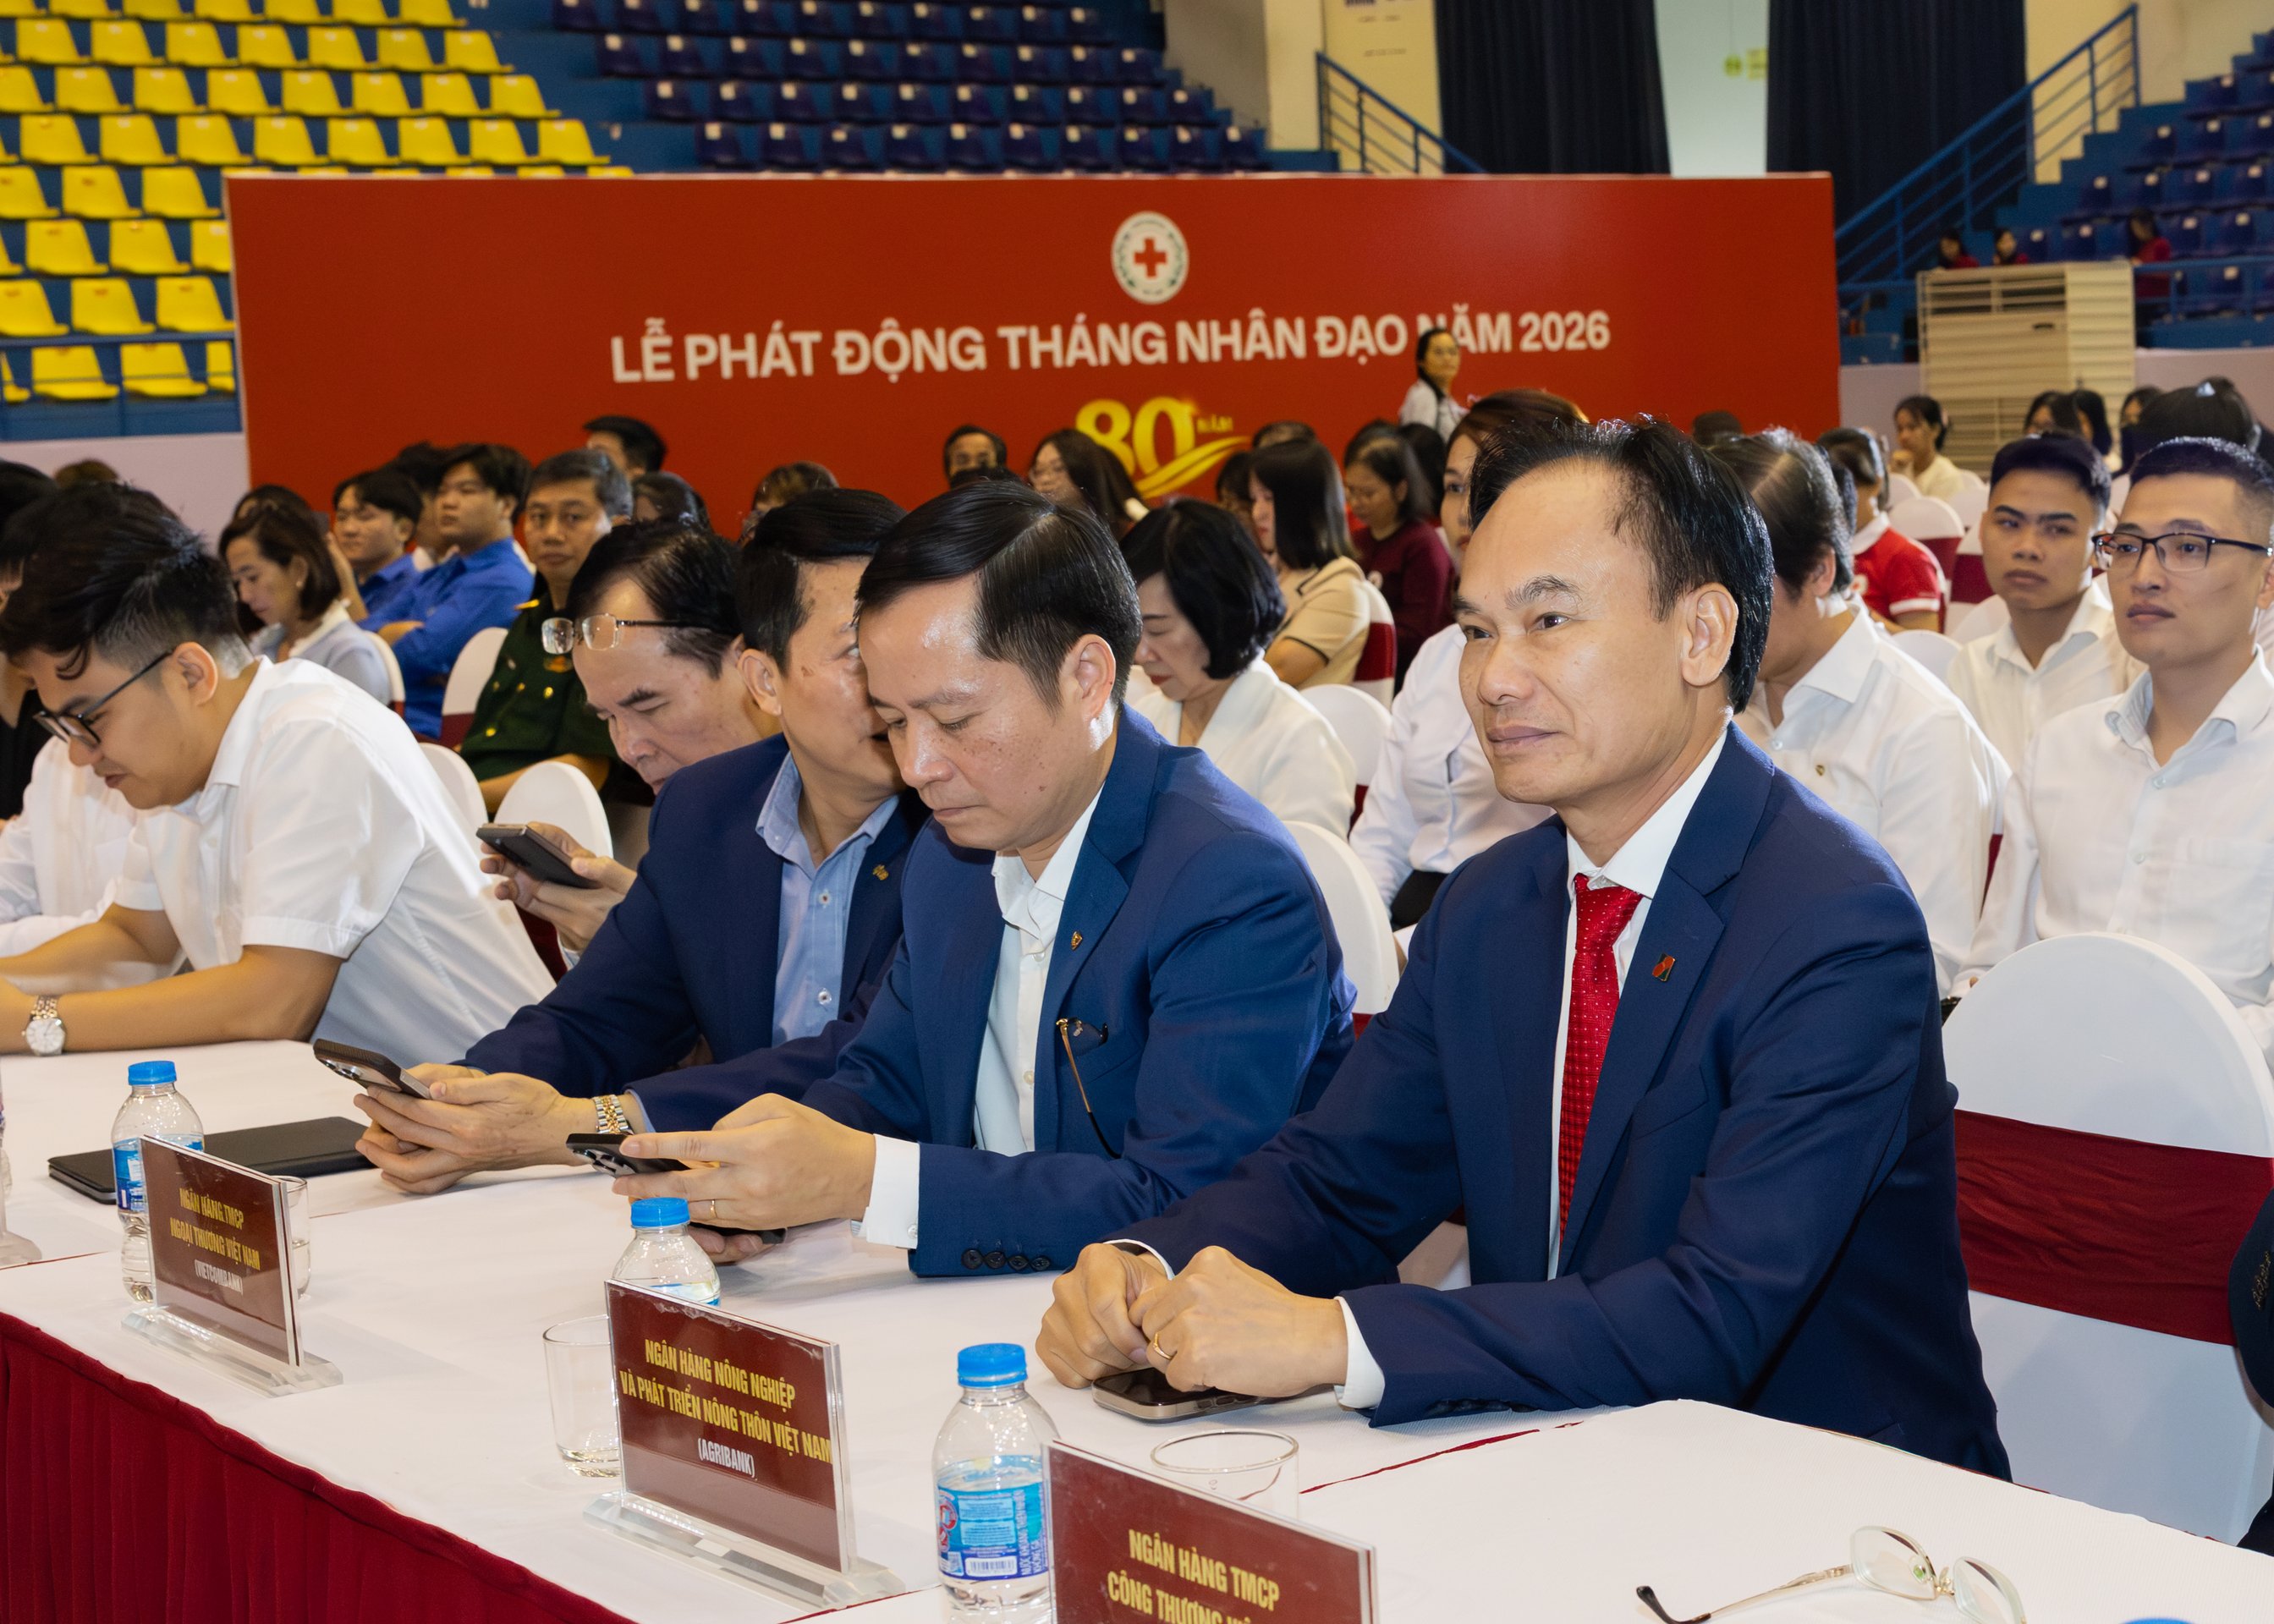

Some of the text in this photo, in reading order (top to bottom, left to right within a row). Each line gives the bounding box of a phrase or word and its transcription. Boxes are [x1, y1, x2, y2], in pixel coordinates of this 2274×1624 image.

[611, 316, 675, 383] LỄ
[684, 320, 822, 380] PHÁT
[832, 317, 987, 383] ĐỘNG
[997, 312, 1167, 370] THÁNG
[1178, 307, 1307, 363] NHÂN
[1315, 314, 1408, 365] ĐẠO
[1518, 310, 1611, 353] 2026
[1075, 396, 1196, 478] 80
[169, 1216, 261, 1271] NGOẠI THƯƠNG VIỆT NAM
[179, 1188, 244, 1231] NGÂN HÀNG TMCP
[645, 1339, 796, 1413] NGÂN HÀNG NÔNG NGHIỆP
[619, 1369, 833, 1465] VÀ PHÁT TRIỂN NÔNG THÔN VIỆT NAM
[698, 1438, 755, 1479] (AGRIBANK)
[1107, 1570, 1153, 1615] CÔNG
[1129, 1528, 1280, 1611] NGÂN HÀNG TMCP
